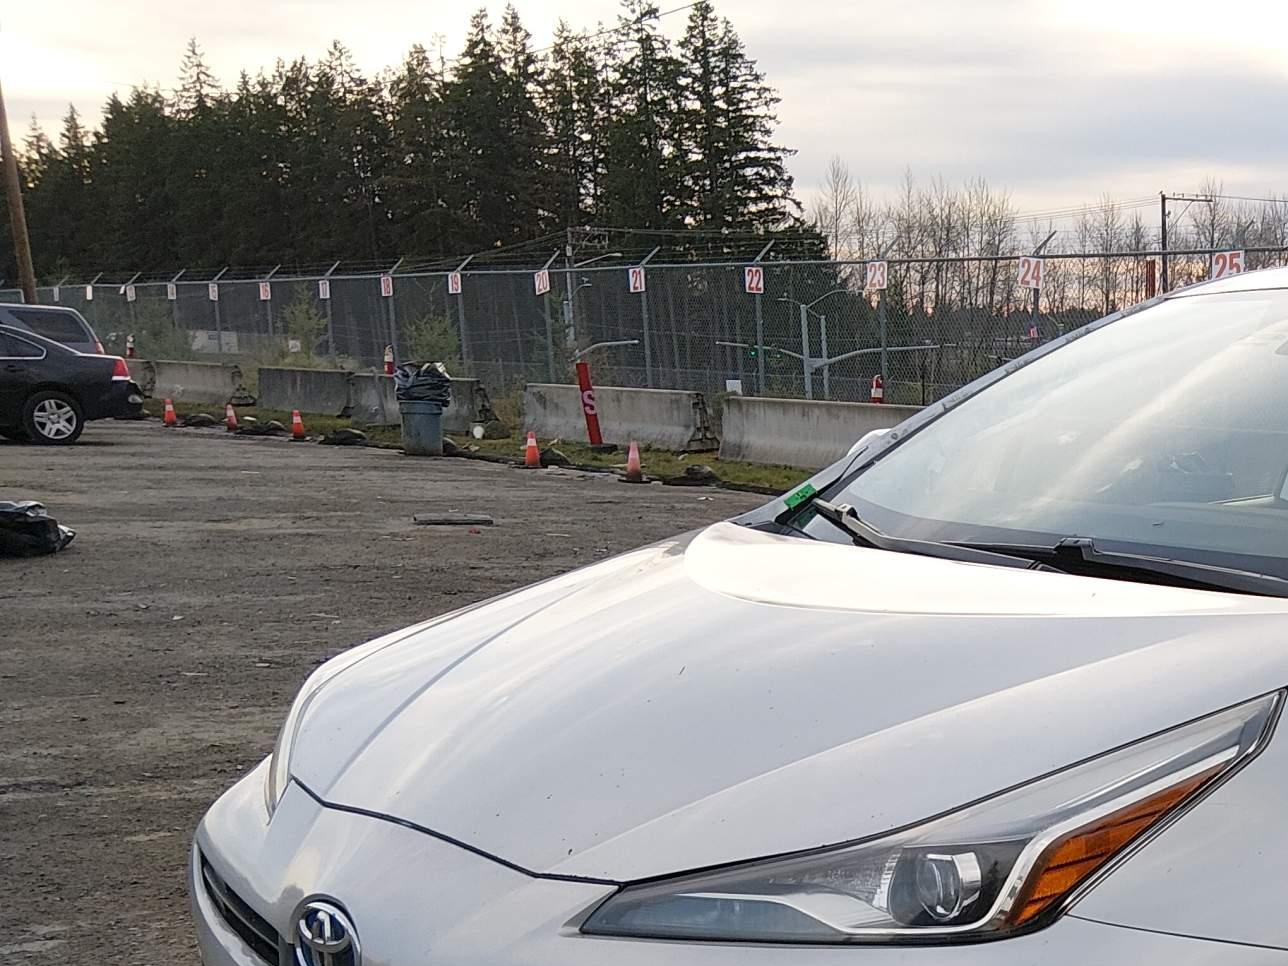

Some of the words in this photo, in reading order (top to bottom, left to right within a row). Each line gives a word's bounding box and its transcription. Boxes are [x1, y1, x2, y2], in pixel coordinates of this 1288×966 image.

[869, 262, 886, 289] 23
[1021, 258, 1043, 286] 24
[1214, 253, 1241, 278] 25
[383, 277, 391, 294] 18
[451, 273, 460, 292] 19
[537, 272, 548, 293] 20
[632, 270, 643, 290] 21
[747, 269, 761, 291] 22
[583, 390, 597, 415] S
